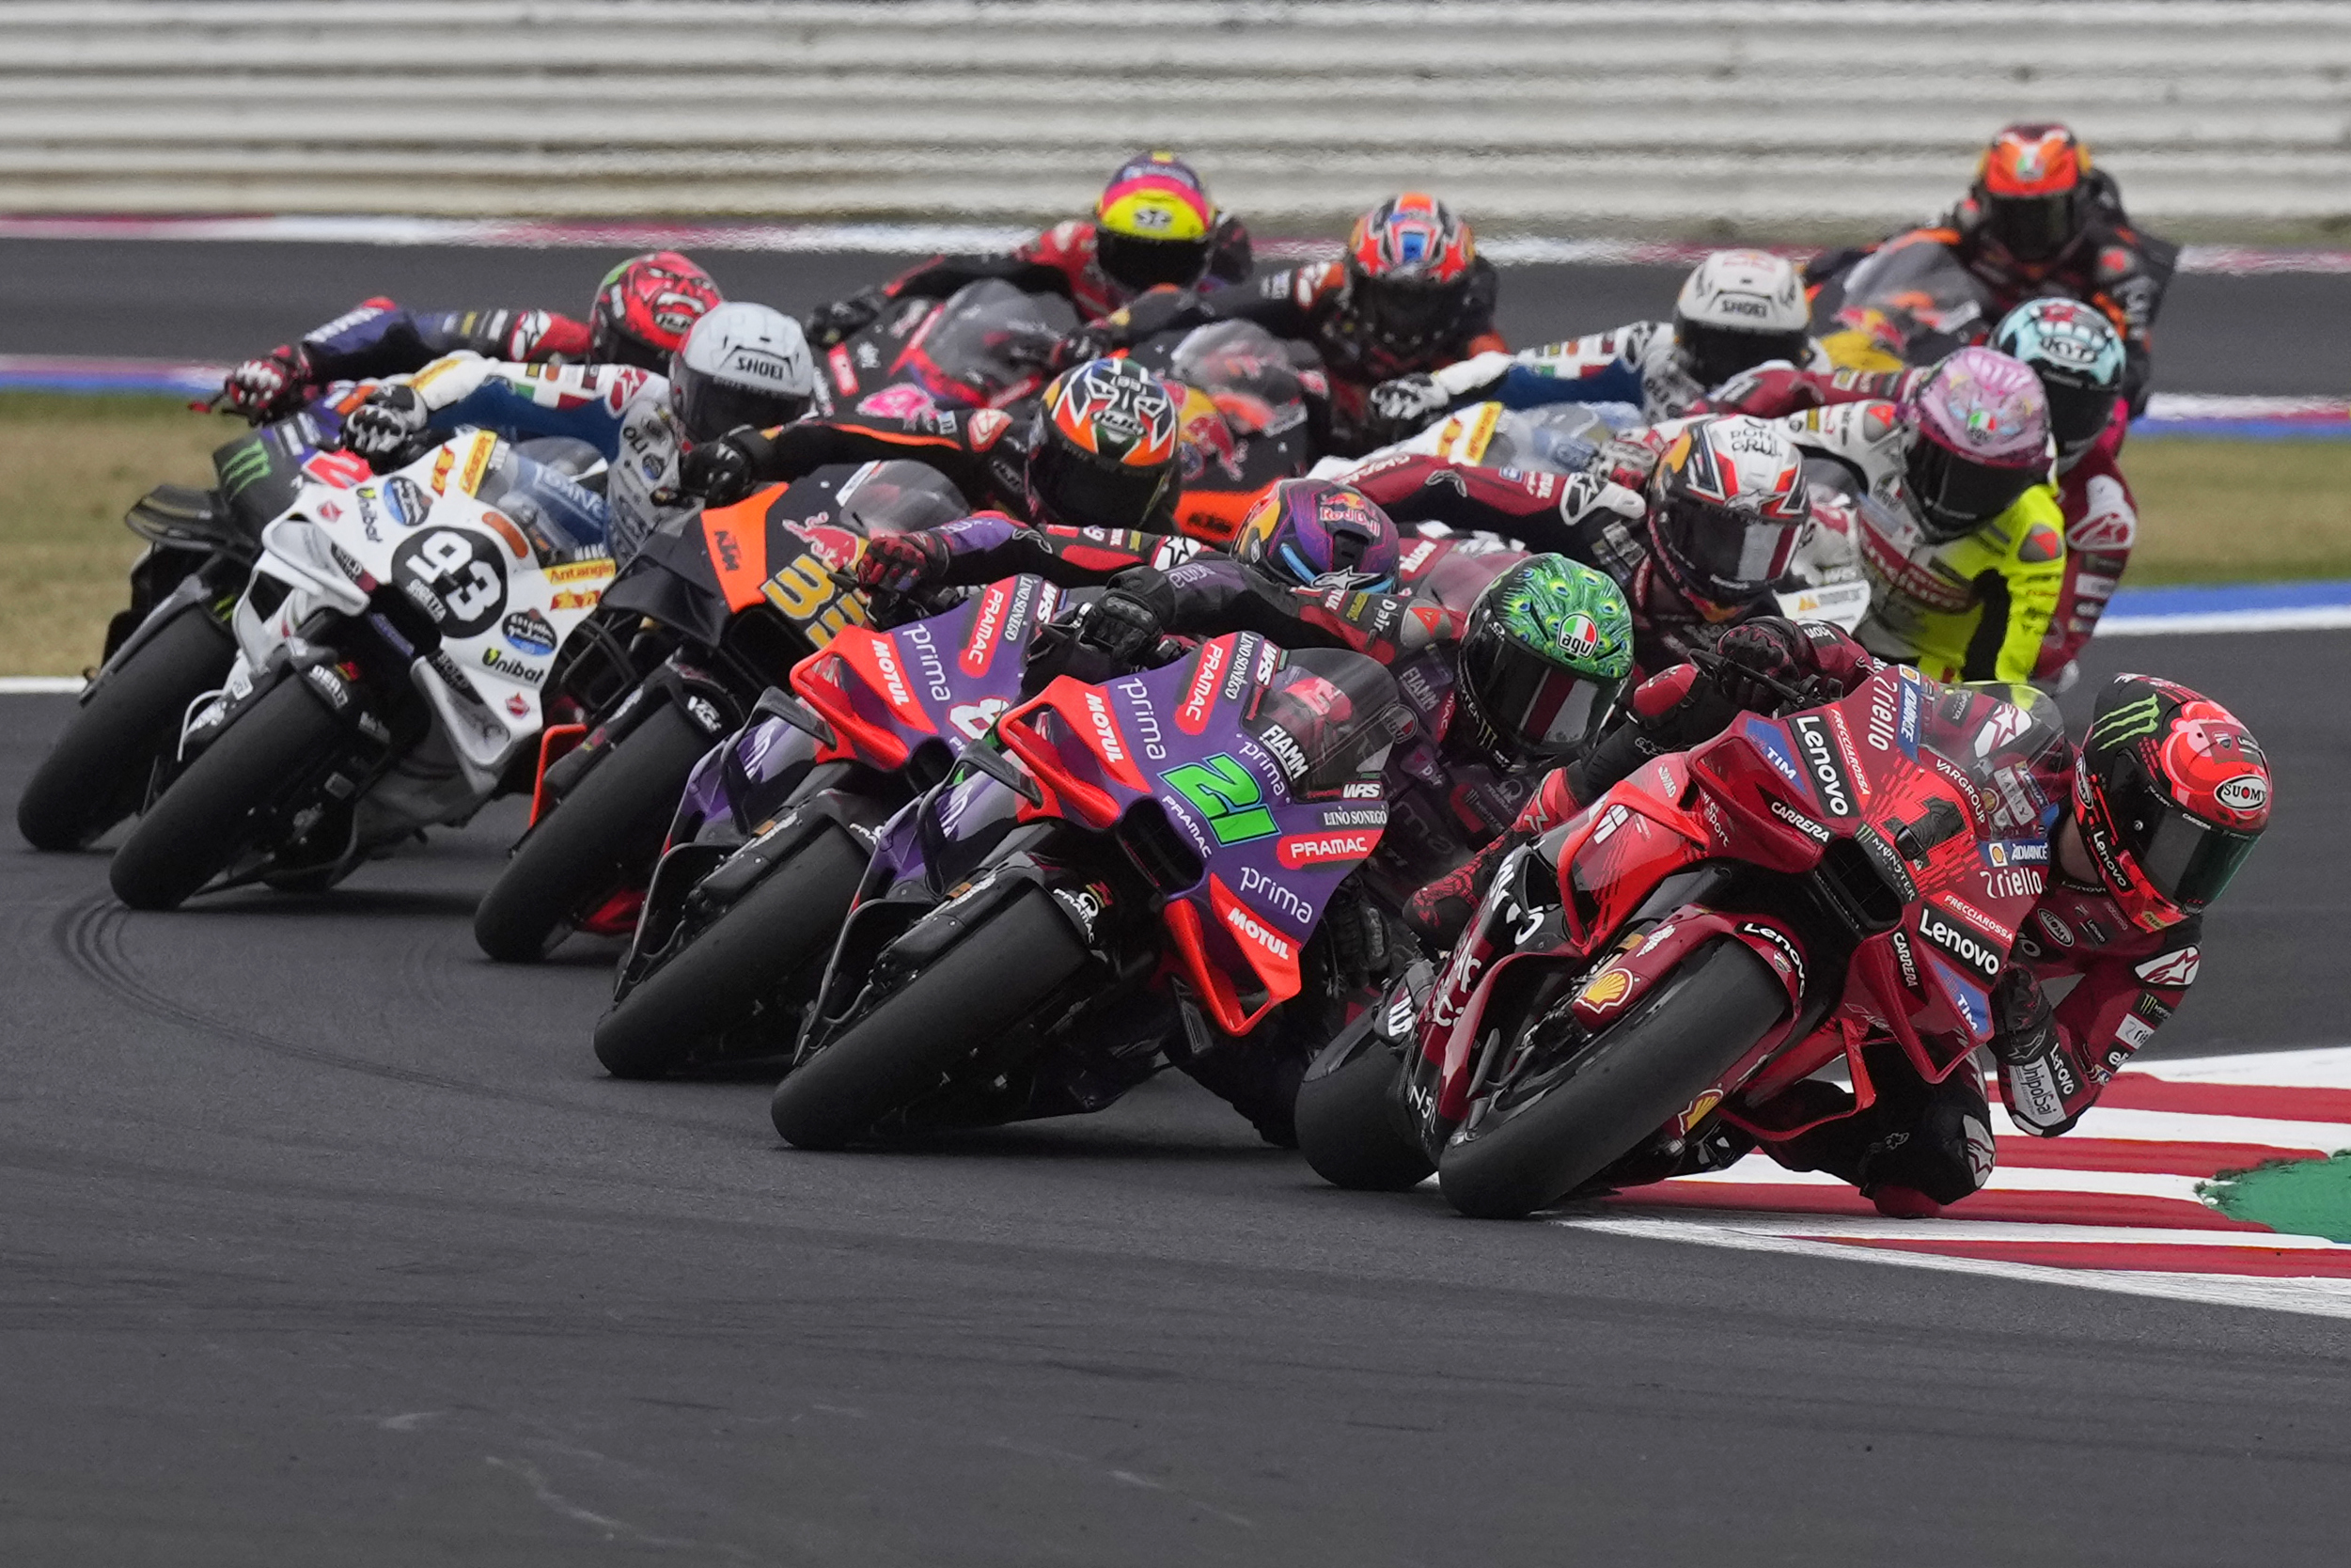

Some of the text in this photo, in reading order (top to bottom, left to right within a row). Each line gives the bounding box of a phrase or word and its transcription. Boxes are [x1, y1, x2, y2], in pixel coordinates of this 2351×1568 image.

[735, 356, 784, 381] SHOEI
[405, 530, 501, 621] 93
[714, 530, 740, 572] KTM
[968, 588, 1005, 665] PRAMAC
[1561, 634, 1592, 657] agv
[482, 647, 544, 684] Unibat
[871, 639, 910, 706] MOTUL
[902, 623, 951, 701] prima
[1185, 643, 1224, 722] PRAMAC
[1402, 666, 1441, 712] FIAMM
[1085, 693, 1124, 763] MOTUL
[1118, 678, 1168, 760] prima
[1239, 741, 1285, 796] prima
[1262, 725, 1309, 779] FIAMM
[1767, 746, 1797, 780] TIM
[1796, 715, 1849, 817] Lenovo
[1832, 708, 1872, 795] FRECCIAROSSA
[1157, 751, 1282, 848] 21
[1343, 783, 1381, 799] WRS
[1936, 759, 1985, 824] VARGROUP
[1161, 794, 1212, 858] PRAMAC
[1290, 837, 1368, 859] PRAMAC
[1771, 800, 1831, 844] CARRERA
[1873, 836, 1917, 902] MONSTER
[2011, 842, 2048, 861] ADVANCE
[2092, 830, 2127, 887] Lenovo
[1053, 888, 1095, 944] PRAMAC
[1239, 866, 1313, 924] prima
[1944, 894, 2014, 943] FRECCIAROSSA
[1227, 907, 1289, 960] MOTUL
[1743, 922, 1806, 998] Lenovo
[1892, 932, 1919, 988] CARRERA
[1919, 908, 2000, 976] Lenovo
[1958, 993, 1979, 1032] TIM
[2021, 1061, 2058, 1116] UnipolSai
[2049, 1042, 2076, 1096] Lenovo
